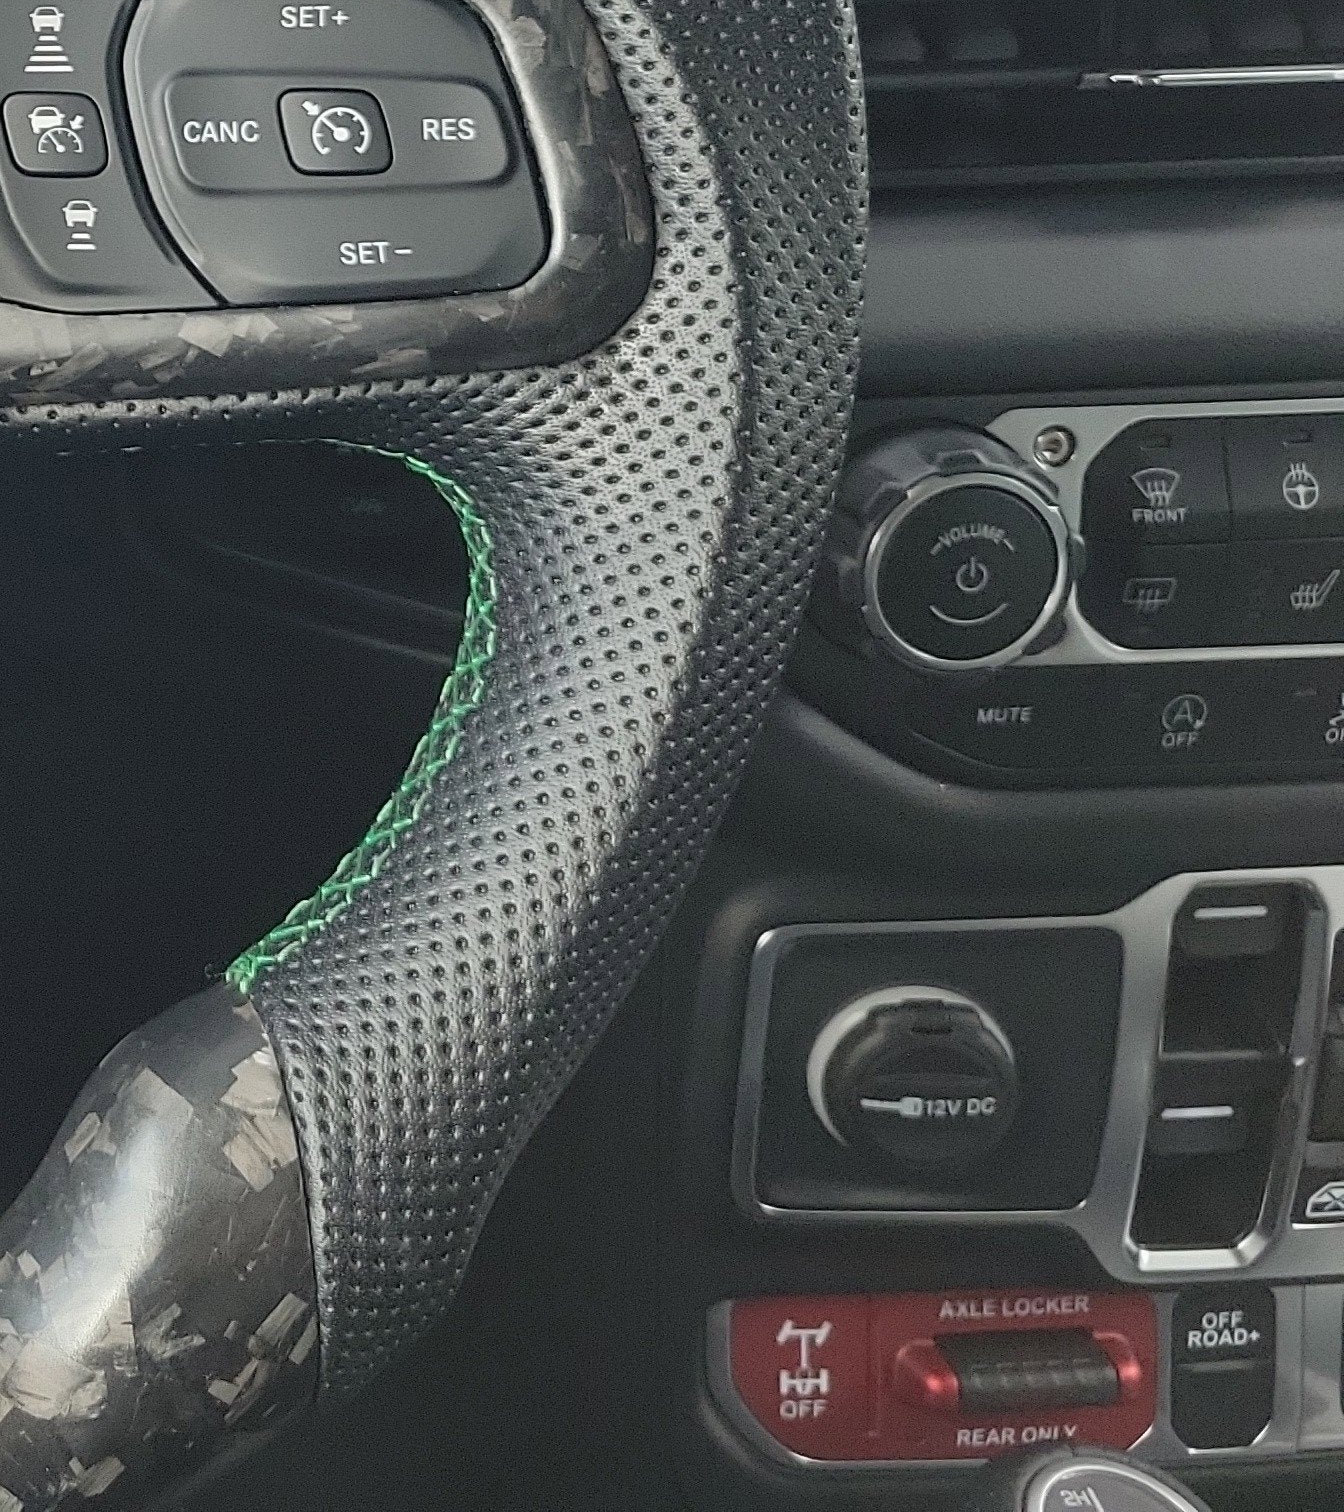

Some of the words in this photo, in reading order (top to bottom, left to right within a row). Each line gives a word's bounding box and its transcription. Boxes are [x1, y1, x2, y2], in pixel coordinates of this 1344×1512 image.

[279, 5, 351, 29] SET+
[181, 119, 261, 145] CANC
[420, 117, 475, 143] RES
[1132, 508, 1186, 523] FRONT
[938, 523, 1005, 548] VOLUME
[977, 706, 1033, 724] MUTE
[1162, 731, 1199, 749] OFF
[967, 1097, 997, 1116] DC
[939, 1298, 996, 1320] AXLE
[1002, 1295, 1090, 1317] LOCKER
[1202, 1310, 1244, 1330] OFF
[1187, 1327, 1261, 1348] ROAD+
[779, 1399, 827, 1419] OFF
[957, 1426, 1015, 1447] REAR
